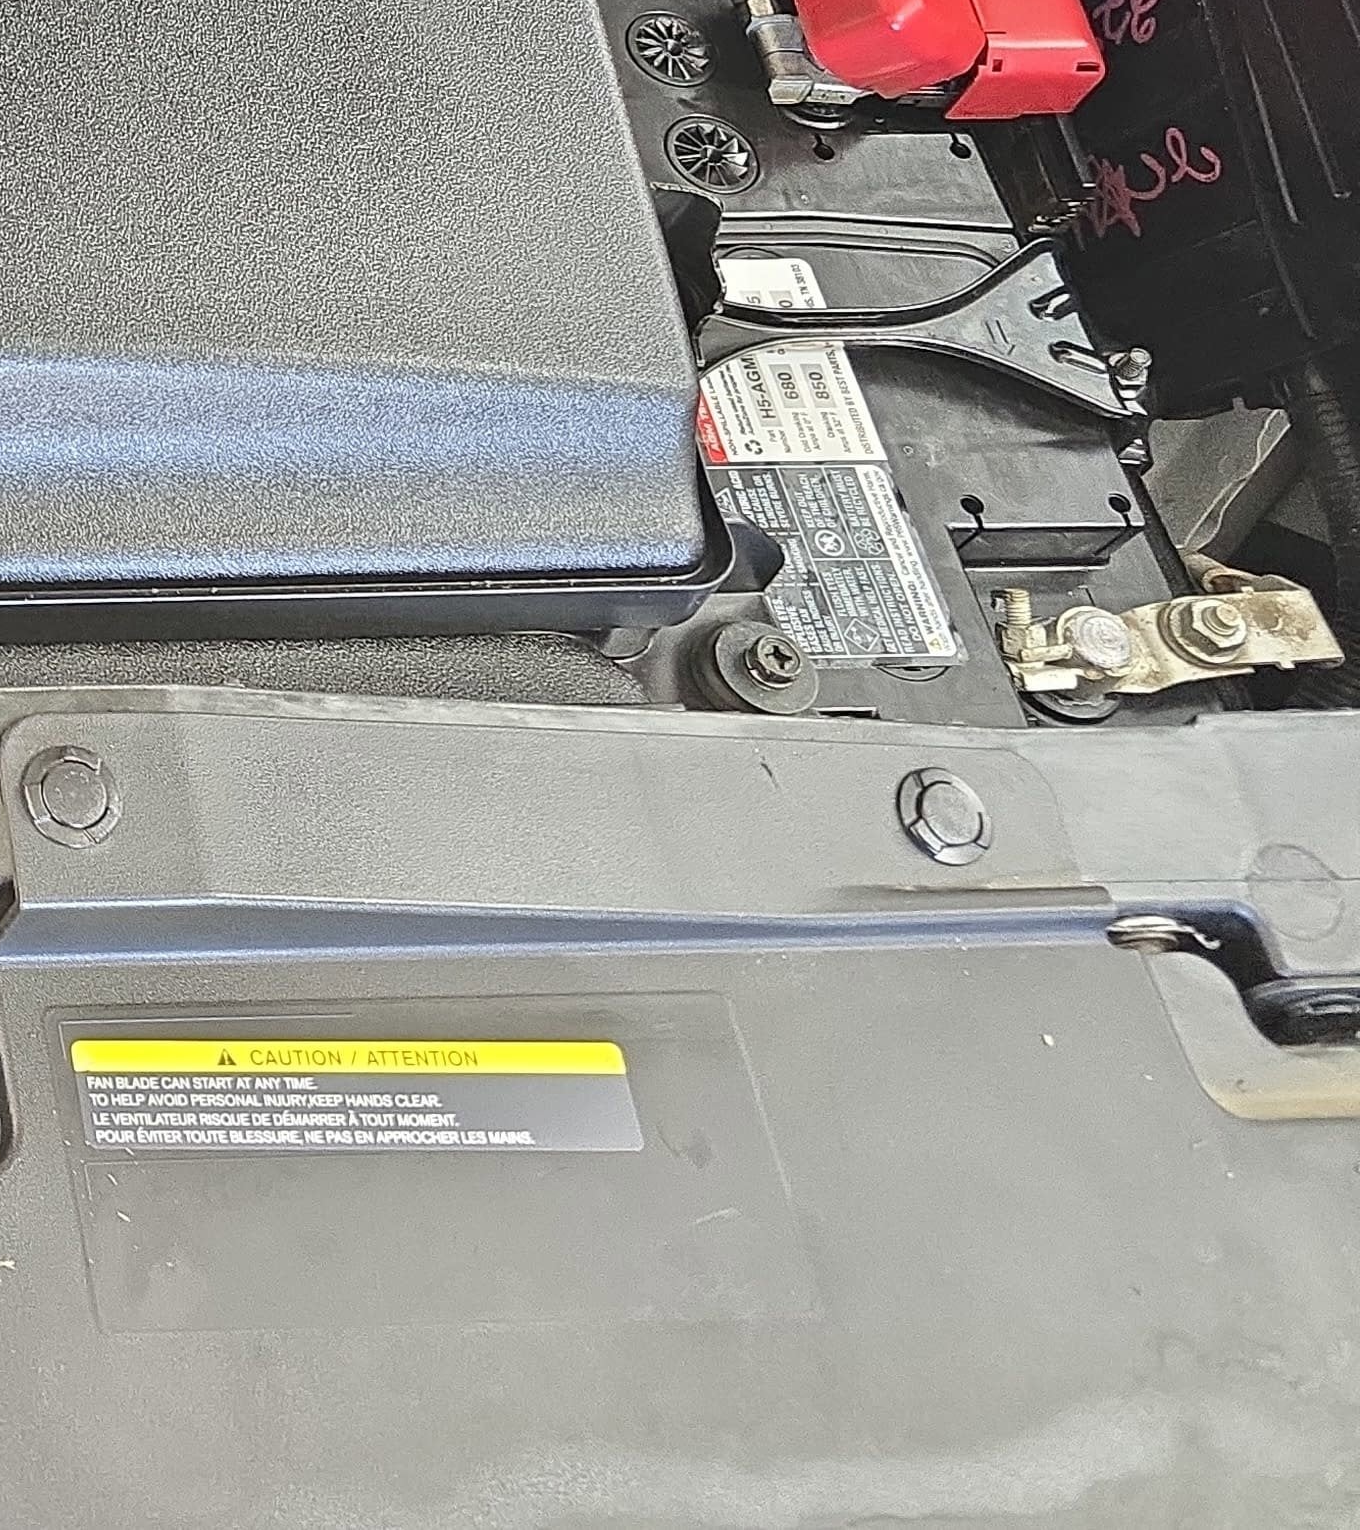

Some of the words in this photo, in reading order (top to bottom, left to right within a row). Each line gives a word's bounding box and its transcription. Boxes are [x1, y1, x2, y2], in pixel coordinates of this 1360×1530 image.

[797, 287, 810, 295] TN
[825, 350, 845, 375] PARTS,
[776, 373, 799, 400] 680
[807, 372, 830, 400] 850
[834, 377, 852, 394] BEST
[842, 397, 856, 406] BY
[819, 412, 835, 439] Cranking
[846, 408, 874, 454] DISTRIBUTED
[798, 440, 812, 453] Cold
[727, 471, 744, 489] ACID
[752, 476, 765, 486] OR
[798, 475, 817, 500] REACH
[830, 471, 848, 493] MUST
[746, 489, 763, 512] CAUSE
[794, 492, 809, 508] OUT
[844, 477, 867, 515] RECYCLED
[756, 488, 779, 529] BLINDNESS
[771, 501, 791, 529] SEVERE
[807, 503, 822, 516] THE
[838, 494, 860, 527] BATTERY
[868, 494, 896, 536] Reproductive
[754, 514, 769, 529] CAN
[799, 509, 815, 529] KEEP
[812, 518, 826, 528] OF
[823, 518, 837, 528] OF
[858, 517, 871, 527] BE
[886, 539, 902, 551] and
[891, 553, 912, 576] Cancer
[830, 567, 858, 617] IMMEDIATELY
[861, 586, 880, 604] HELP
[802, 591, 826, 628] BLINDNESS
[828, 593, 848, 617] FLUSH
[851, 597, 869, 617] WITH
[898, 604, 915, 624] NOT
[903, 582, 935, 635] WARNING:
[796, 609, 812, 623] CAN
[868, 606, 892, 637] MEDICAL
[802, 625, 822, 653] GASES
[815, 630, 834, 653] CAUSE
[895, 630, 915, 653] READ
[907, 627, 922, 641] DO
[831, 642, 844, 652] OR
[880, 639, 898, 653] GET
[250, 1049, 342, 1065] CAUTION
[350, 1049, 356, 1065] /
[368, 1049, 478, 1065] ATTENTION
[87, 1076, 112, 1088] FAN
[116, 1076, 160, 1088] BLADE
[161, 1076, 189, 1088] CAN
[192, 1076, 232, 1088] START
[236, 1076, 252, 1088] AT
[254, 1076, 280, 1088] ANY
[284, 1076, 317, 1089] TIME.
[89, 1093, 107, 1106] TO
[111, 1093, 145, 1106] HELP
[148, 1093, 188, 1106] AVOID
[190, 1093, 262, 1106] PERSONAL
[344, 1094, 392, 1106] HANDS
[394, 1094, 442, 1106] CLEAR.
[92, 1112, 110, 1125] LE
[111, 1112, 198, 1125] VENTILATEUR
[199, 1112, 250, 1125] RISQUE
[252, 1112, 271, 1125] DE
[272, 1108, 346, 1125] DÉMARRER
[348, 1109, 356, 1125] À
[360, 1113, 396, 1125] TOUT
[398, 1113, 459, 1125] MOMENT.
[96, 1130, 136, 1142] POUR
[137, 1126, 181, 1142] ÉVITER
[183, 1130, 228, 1142] TOUTE
[229, 1130, 303, 1142] BLESSURE,
[304, 1130, 325, 1142] NE
[326, 1131, 353, 1142] PAS
[357, 1131, 374, 1142] EN
[376, 1131, 462, 1143] APPROCHER
[462, 1131, 486, 1143] LES
[488, 1131, 535, 1143] MAINS.
